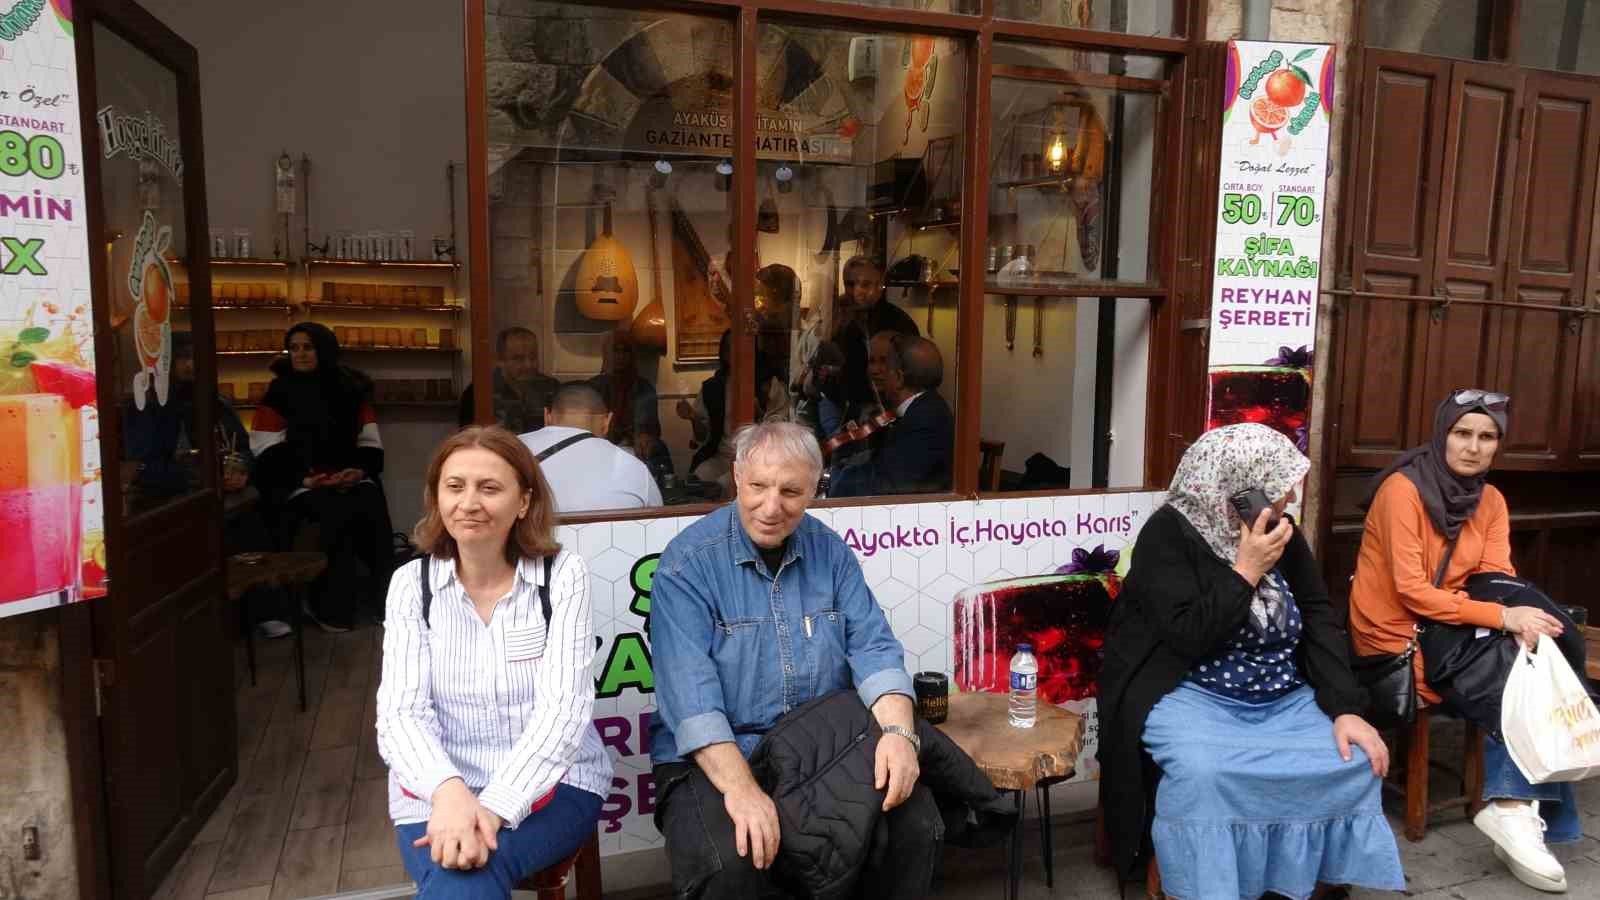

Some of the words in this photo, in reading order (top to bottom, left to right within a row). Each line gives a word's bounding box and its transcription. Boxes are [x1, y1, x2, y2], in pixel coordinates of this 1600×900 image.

[646, 128, 734, 148] GAZİANTE
[1244, 232, 1295, 261] ŞİFA
[1217, 256, 1318, 279] KAYNAĞI
[1221, 287, 1312, 305] REYHAN
[1219, 307, 1311, 330] ŞERBETİ
